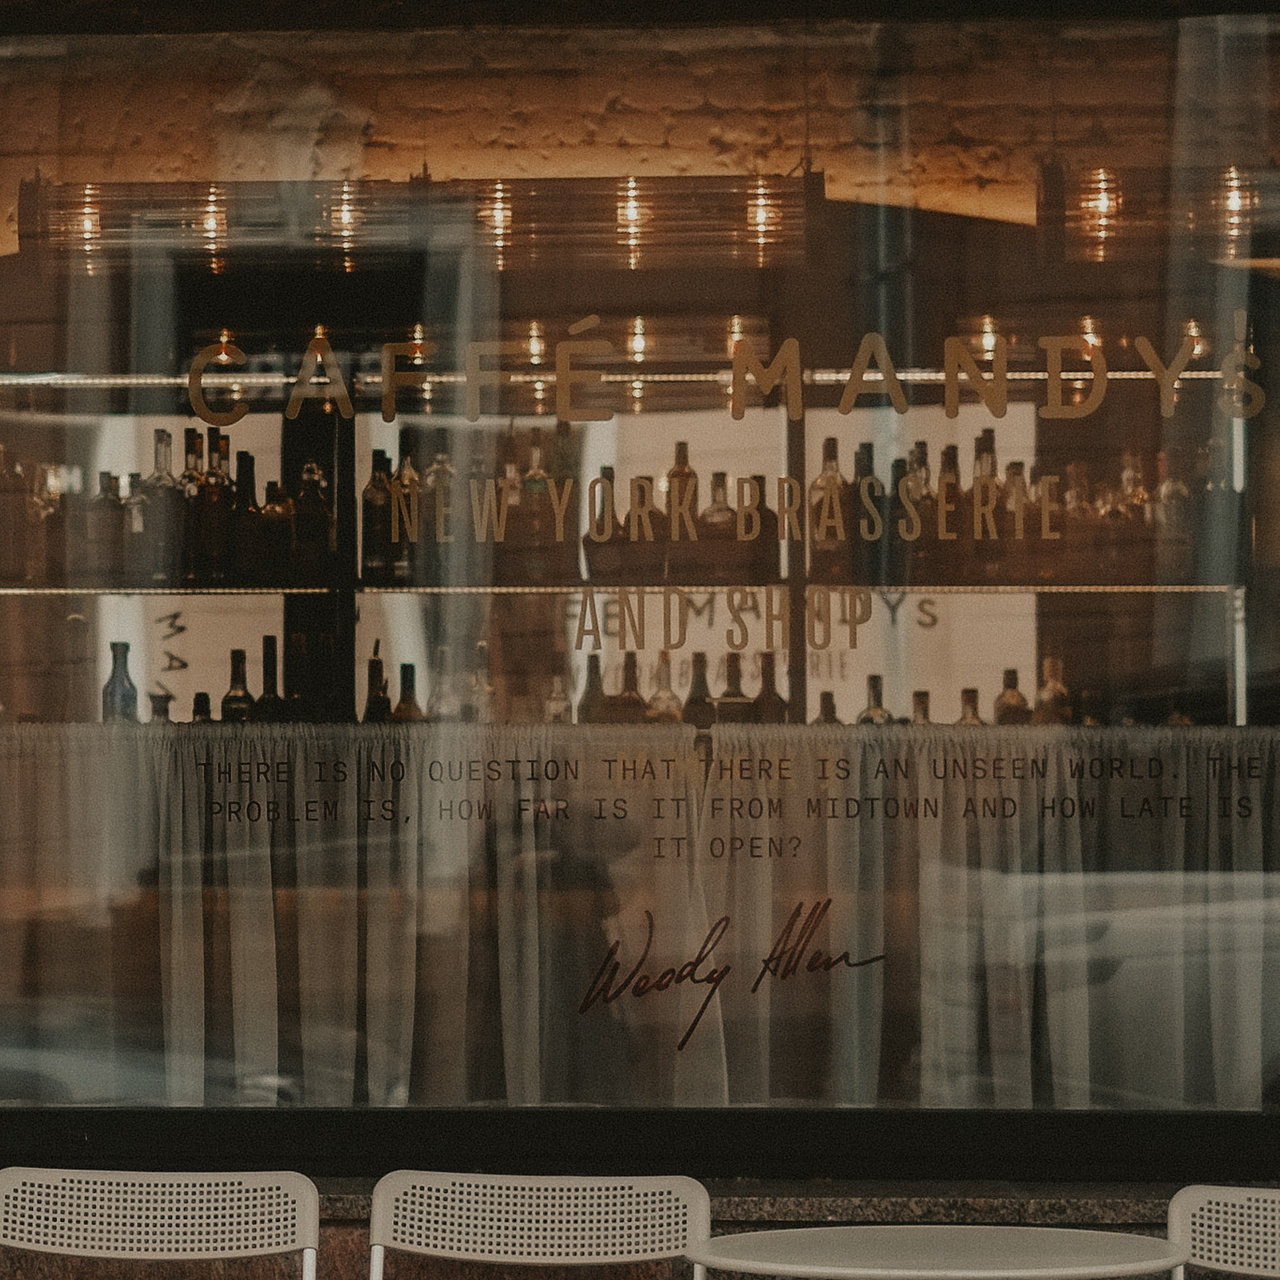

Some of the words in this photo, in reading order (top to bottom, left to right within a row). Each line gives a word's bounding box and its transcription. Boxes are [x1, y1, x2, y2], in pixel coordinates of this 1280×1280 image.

[187, 314, 615, 427] CAFFÉ
[390, 477, 509, 543] NEW
[546, 476, 698, 542] YORK
[735, 475, 1062, 542] BRASSERIE
[574, 586, 689, 651] AND
[197, 761, 290, 784] THERE
[314, 761, 348, 783] IS
[371, 760, 407, 782] NO
[428, 759, 579, 784] QUESTION
[601, 758, 677, 780] THAT
[698, 758, 792, 781] THERE
[816, 758, 851, 780] IS
[873, 758, 909, 780] AN
[932, 757, 1048, 780] UNSEEN
[1069, 757, 1179, 780] WORLD.
[1206, 756, 1262, 780] THE
[210, 799, 339, 823] PROBLEM
[362, 799, 411, 824] IS,
[438, 799, 493, 821] HOW
[517, 798, 570, 820] FAR
[592, 798, 629, 820] IS
[652, 798, 687, 820] IT
[710, 797, 783, 820] FROM
[806, 797, 939, 819] MIDTOWN
[962, 797, 1018, 819] AND
[1040, 796, 1096, 819] HOW
[1119, 796, 1194, 819] LATE
[1218, 796, 1253, 819] IS
[652, 836, 687, 859] IT
[709, 836, 803, 859] OPEN?
[578, 909, 731, 1052] Woody
[750, 897, 886, 995] Allen
